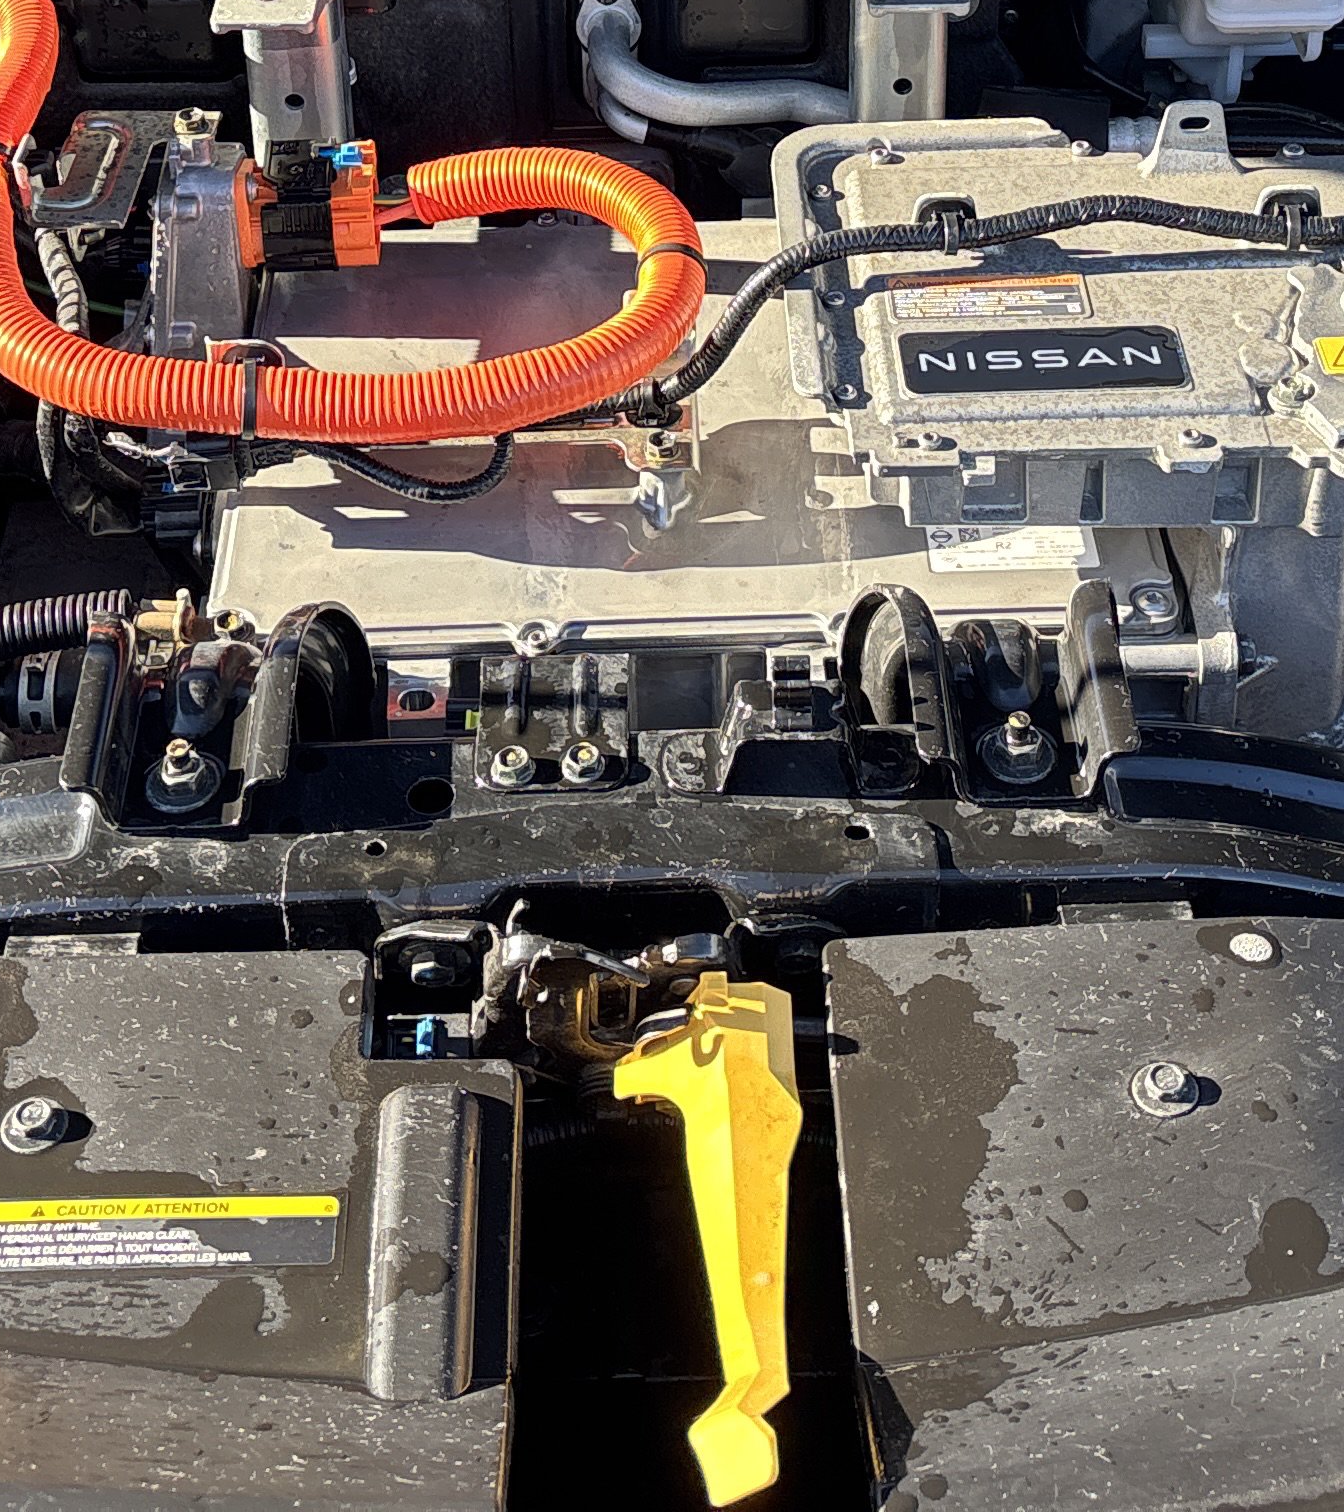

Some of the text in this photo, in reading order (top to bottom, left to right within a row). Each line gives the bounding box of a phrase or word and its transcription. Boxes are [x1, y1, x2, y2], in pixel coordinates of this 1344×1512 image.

[918, 345, 1162, 372] NISSAN
[56, 1204, 127, 1216] CAUTION
[144, 1202, 230, 1215] ATTENTION
[5, 1223, 39, 1233] START
[40, 1223, 54, 1232] AT
[55, 1222, 76, 1231] ANY
[76, 1221, 102, 1231] TIME.
[1, 1234, 55, 1244] PERSONAL
[118, 1231, 155, 1240] HANDS
[156, 1229, 191, 1239] CLEAR.
[2, 1246, 41, 1256] RISQUE
[43, 1245, 59, 1255] DE
[60, 1243, 115, 1254] DÉMARRER
[127, 1243, 152, 1253] TOUT
[152, 1241, 199, 1252] MOMENT.
[78, 1255, 94, 1265] NE
[94, 1254, 114, 1264] PAS
[116, 1254, 131, 1264] EN
[130, 1253, 196, 1264] APPROCHER
[197, 1252, 216, 1262] LES
[216, 1251, 253, 1262] MAINS.
